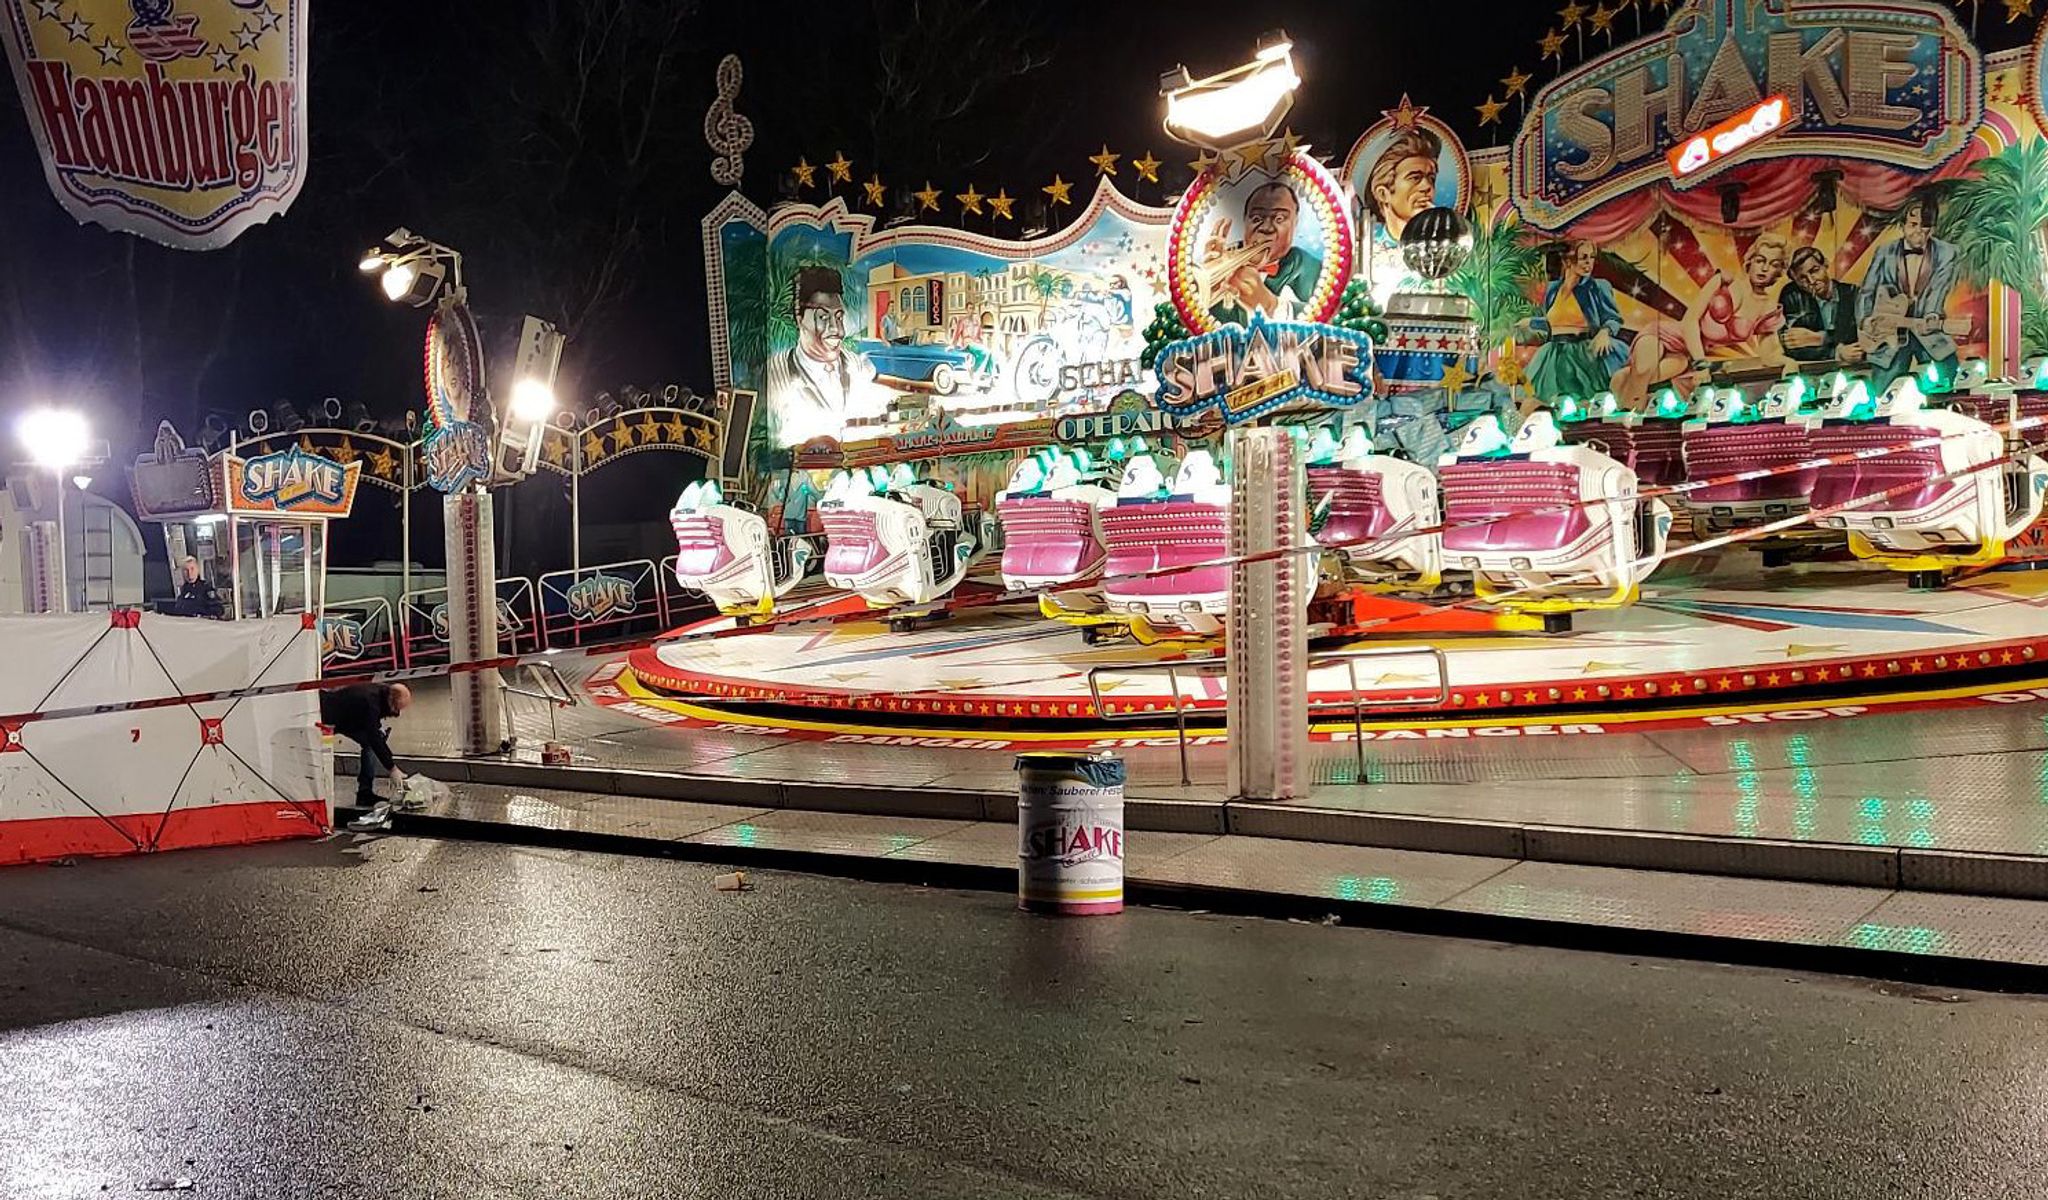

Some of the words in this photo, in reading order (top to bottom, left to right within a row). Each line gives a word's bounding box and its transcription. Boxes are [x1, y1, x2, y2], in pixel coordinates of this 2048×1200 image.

[1555, 27, 1922, 181] SHAKE
[27, 60, 297, 189] Hamburger
[1162, 325, 1362, 404] SHAKE
[247, 456, 340, 500] SHAKE
[571, 581, 633, 612] SHAKE
[1331, 724, 1605, 742] DANGER
[1702, 706, 1868, 726] STOP
[825, 734, 1012, 750] DANGER
[1030, 824, 1122, 860] SHAKE
